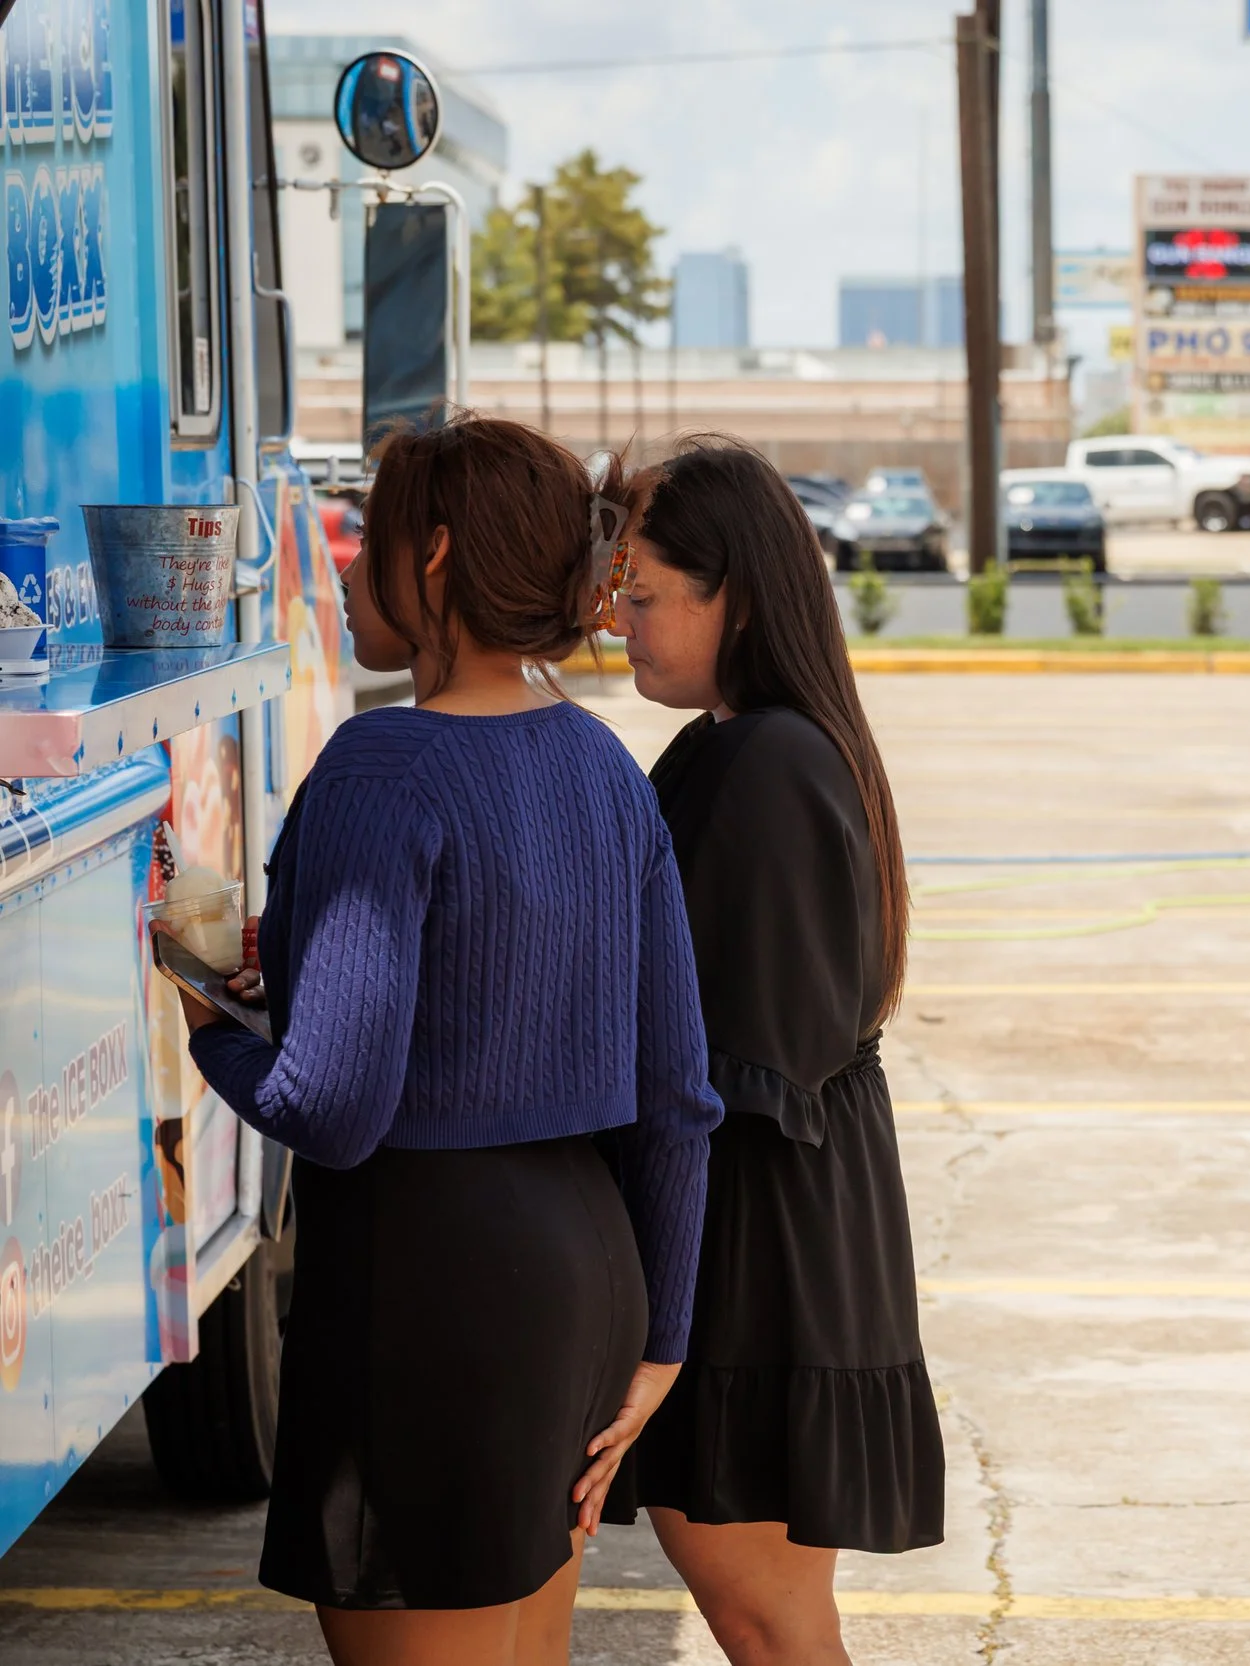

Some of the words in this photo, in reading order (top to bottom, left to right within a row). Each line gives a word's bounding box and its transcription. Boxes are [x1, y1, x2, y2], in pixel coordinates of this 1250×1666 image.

[5, 162, 108, 350] BOXX
[187, 517, 222, 538] Tips
[159, 555, 213, 576] They're
[167, 576, 177, 592] $
[182, 578, 215, 596] Hugs
[126, 595, 188, 612] without
[192, 597, 212, 612] the
[152, 614, 191, 636] body
[27, 1083, 60, 1161] The
[62, 1051, 87, 1133] ICE
[88, 1018, 128, 1110] BOXX
